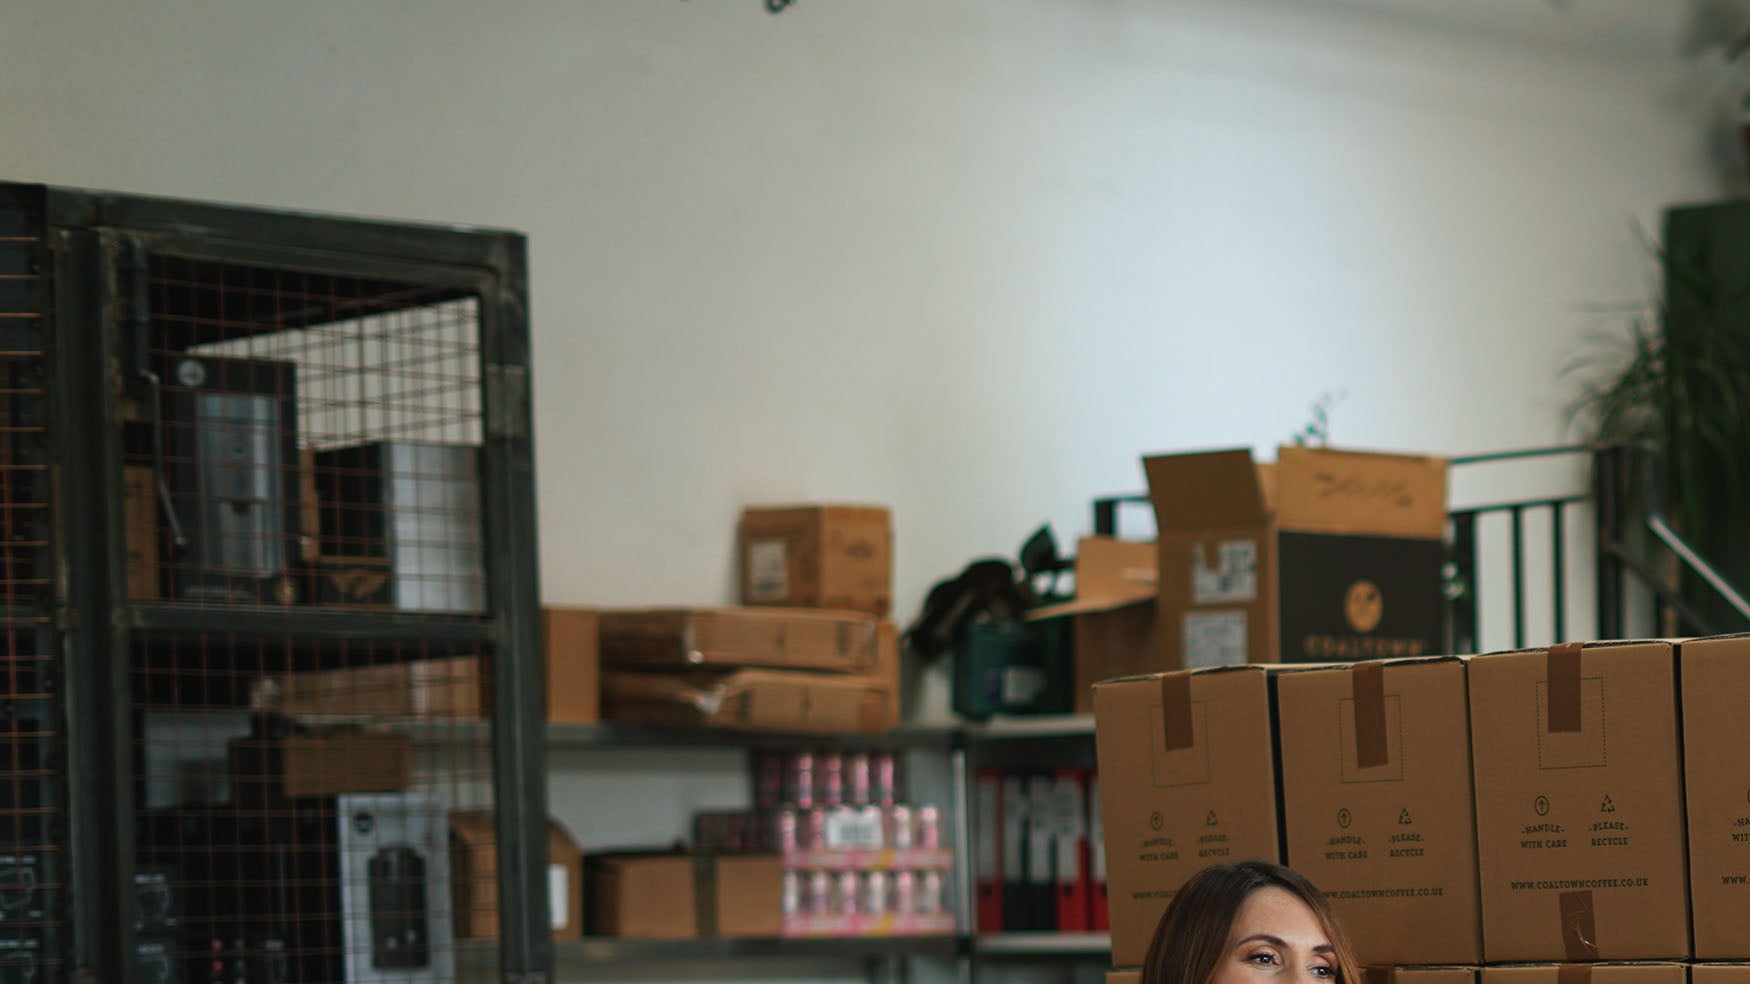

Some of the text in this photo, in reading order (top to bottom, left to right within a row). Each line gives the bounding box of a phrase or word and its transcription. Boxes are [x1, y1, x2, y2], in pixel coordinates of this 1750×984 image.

[1520, 839, 1567, 849] WITH CARE
[1591, 837, 1629, 846] RECYCLE
[1511, 877, 1649, 891] WWW.COALTOWNCOFFEE.CO.UK
